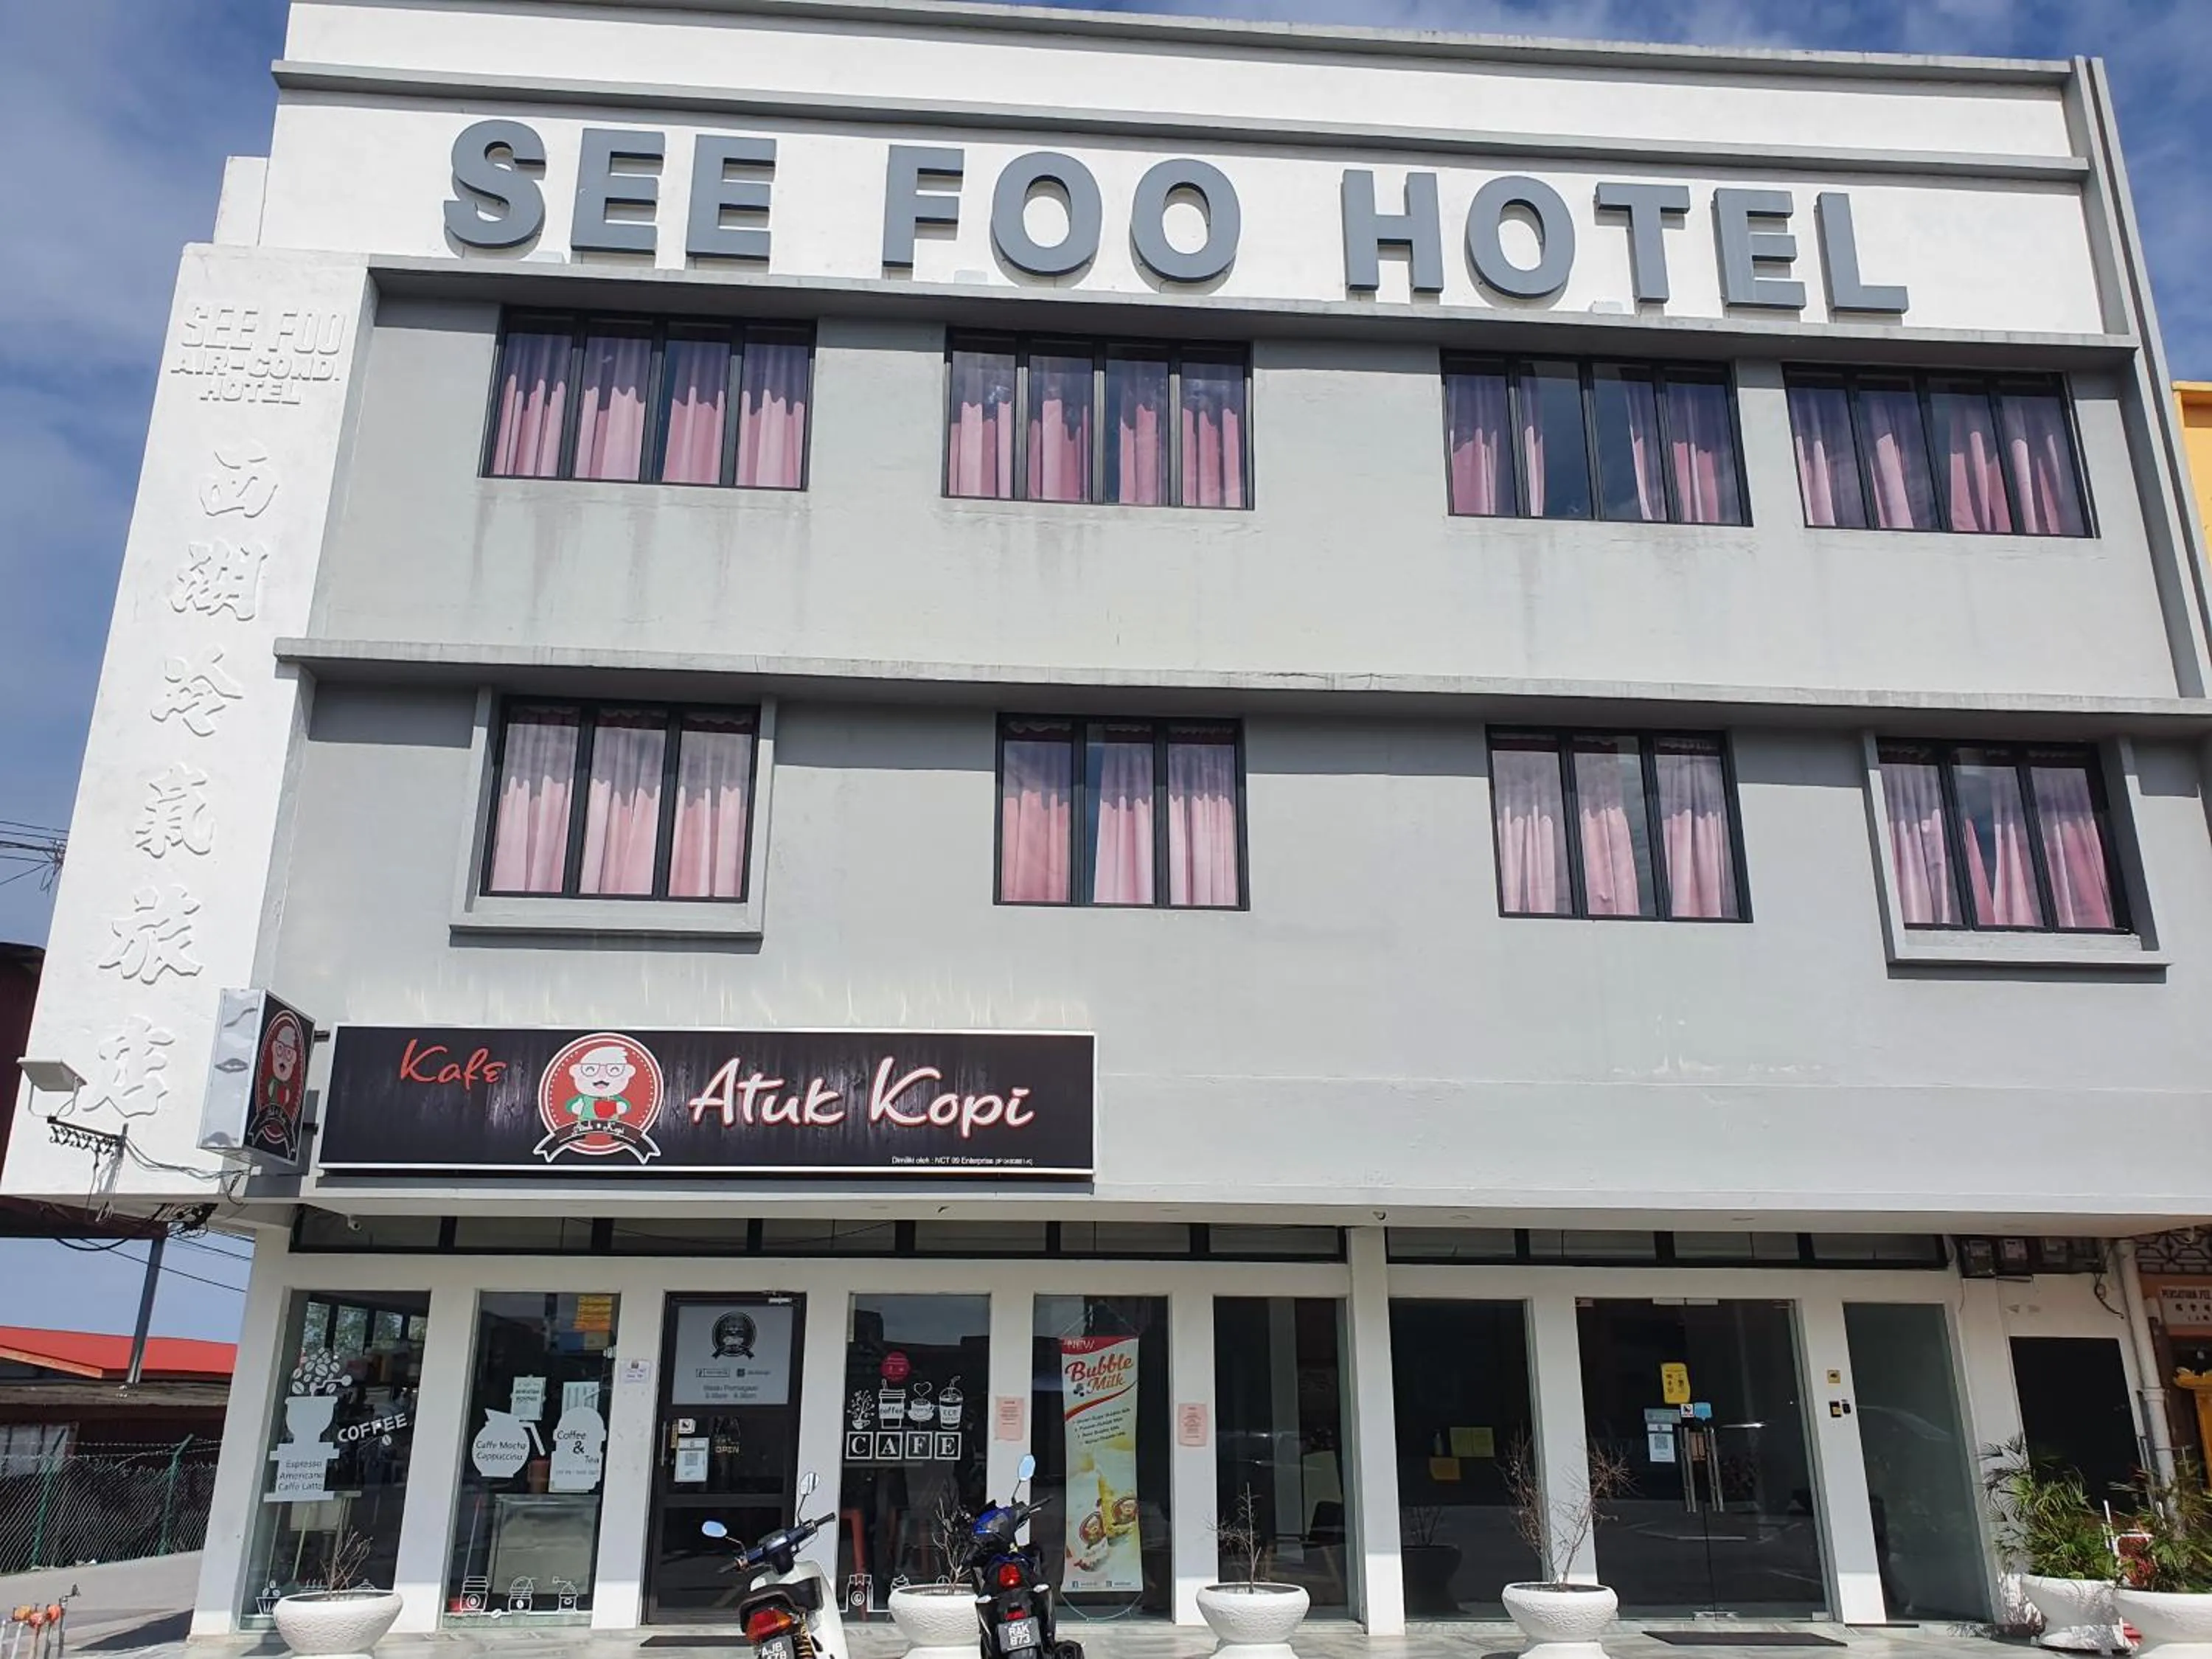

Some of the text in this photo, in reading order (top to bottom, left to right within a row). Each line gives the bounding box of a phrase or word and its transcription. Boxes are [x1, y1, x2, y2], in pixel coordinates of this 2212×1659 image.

[444, 119, 1908, 314] SEE FOO HOTEL
[181, 302, 347, 355] SEE FOO
[200, 378, 302, 405] HOTEL
[399, 1038, 507, 1090] Kafe
[689, 1055, 1036, 1138] Atuk Kopi
[1065, 1354, 1133, 1382] Bubble
[1087, 1374, 1124, 1394] Milk
[338, 1413, 407, 1442] COFFEE
[557, 1430, 587, 1440] Coffee
[573, 1441, 585, 1455] &
[851, 1436, 956, 1456] CAFE
[761, 1641, 784, 1658] AJB
[1010, 1634, 1030, 1646] 873
